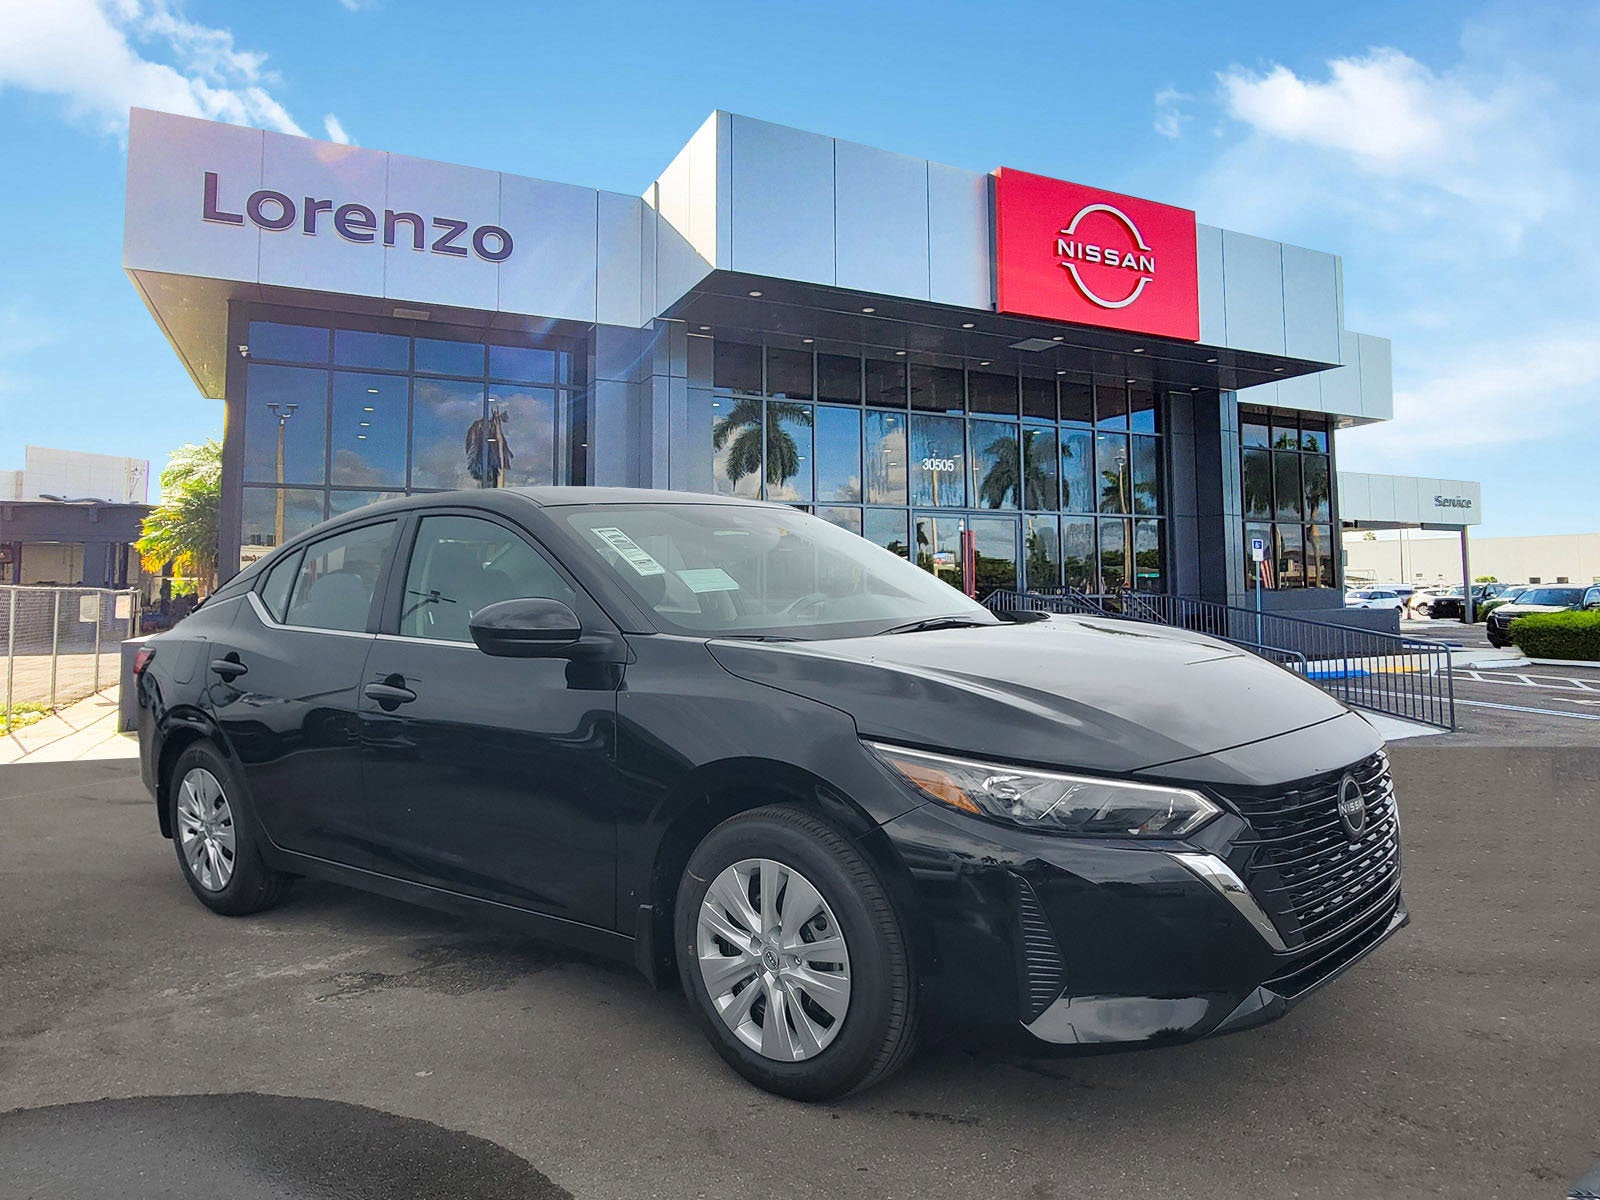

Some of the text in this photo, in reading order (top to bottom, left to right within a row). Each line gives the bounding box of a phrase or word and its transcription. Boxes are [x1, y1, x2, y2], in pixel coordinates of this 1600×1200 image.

[203, 171, 514, 262] Lorenzo
[1057, 238, 1155, 273] NISSAN
[922, 458, 954, 471] 30505
[1434, 495, 1472, 508] Service
